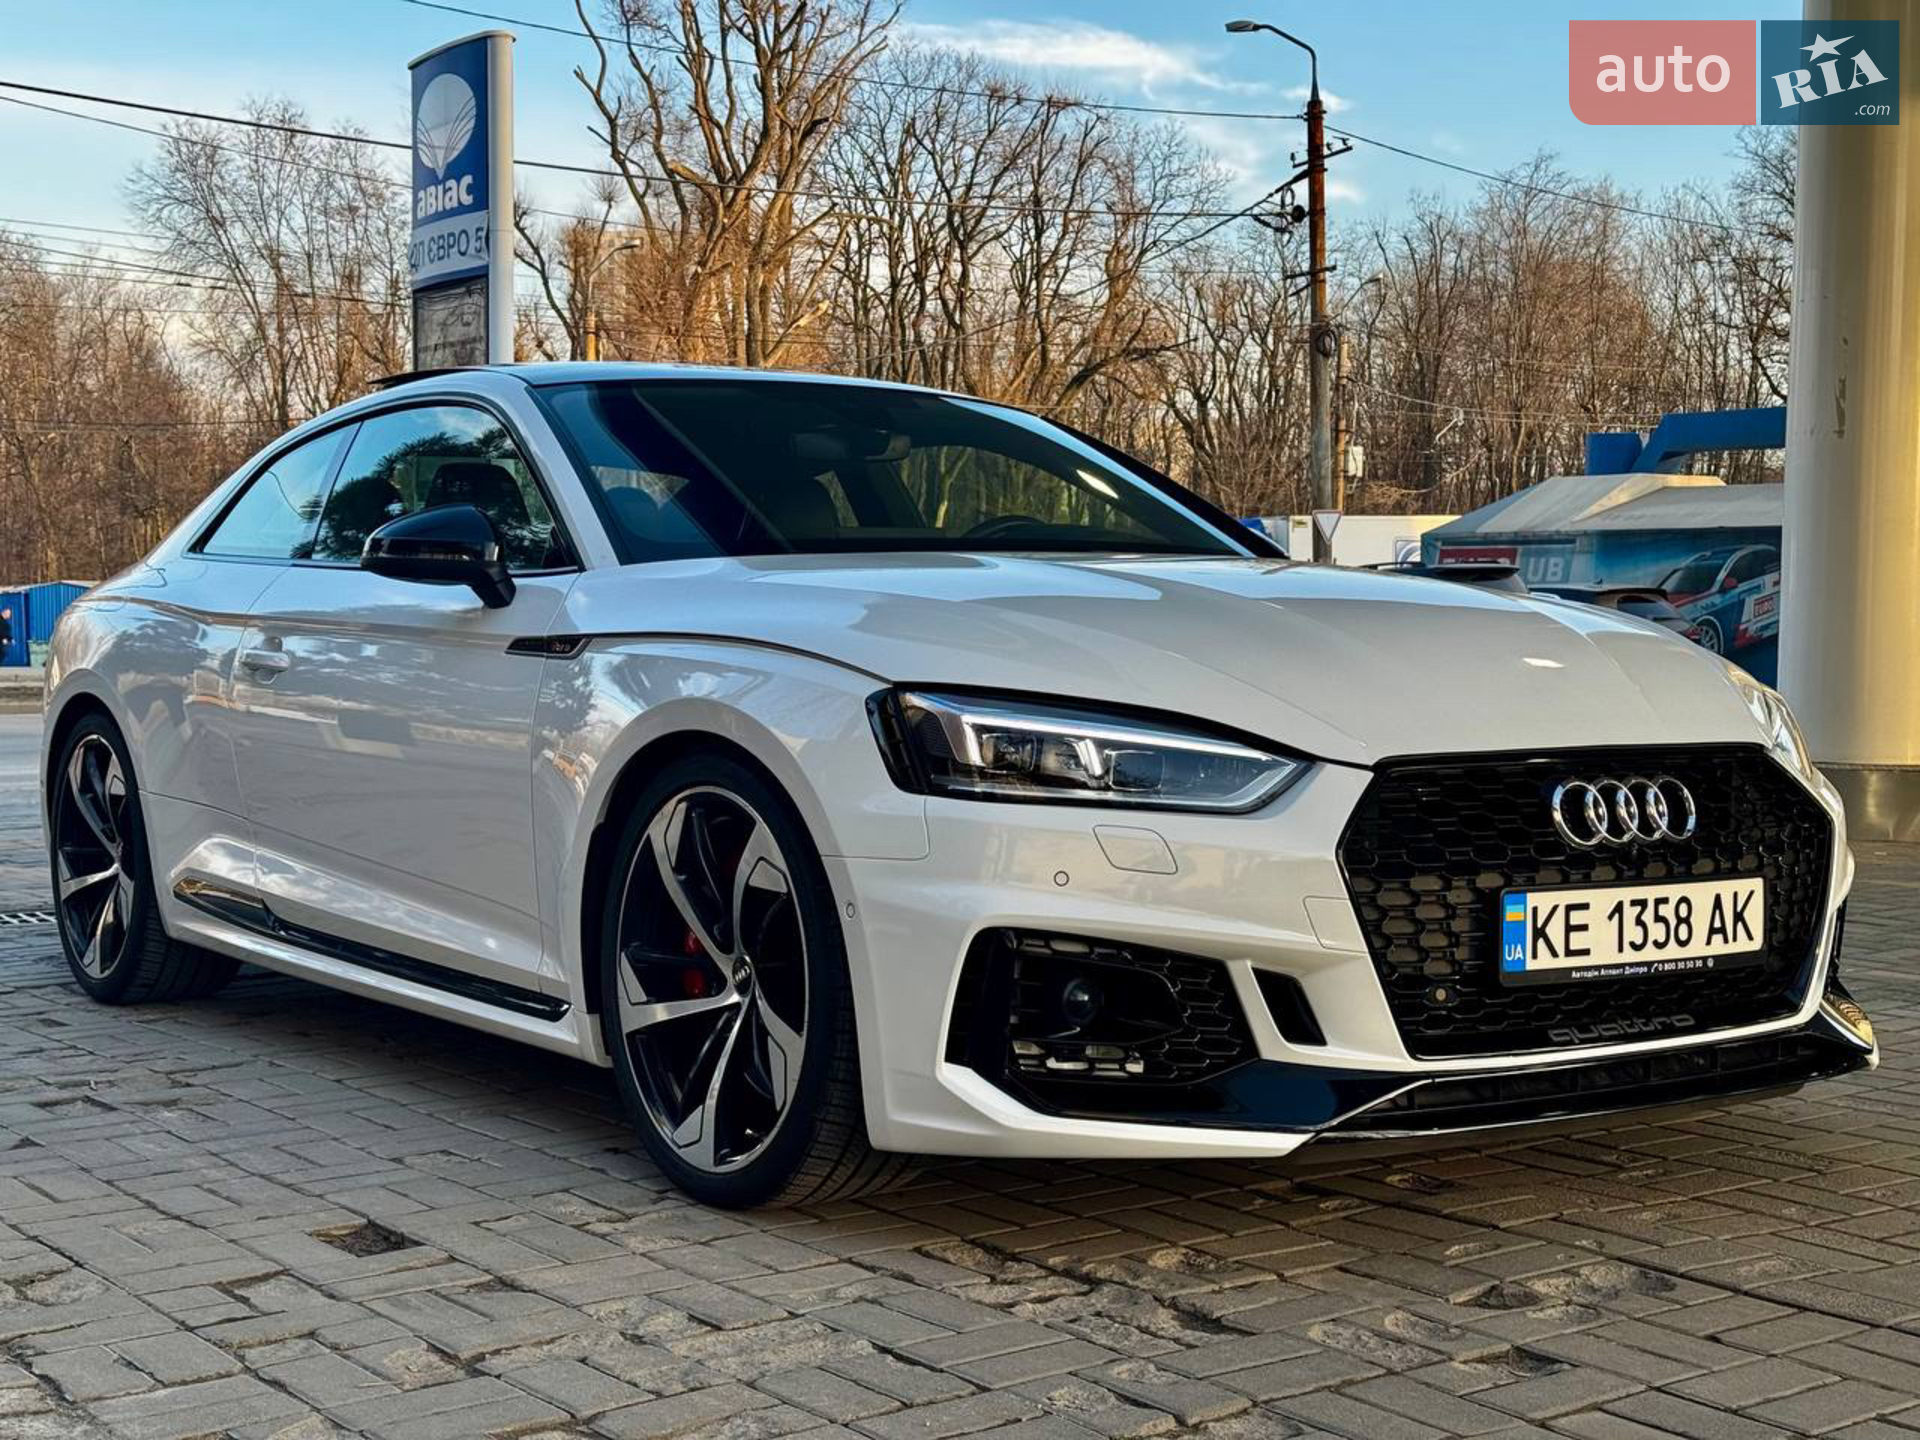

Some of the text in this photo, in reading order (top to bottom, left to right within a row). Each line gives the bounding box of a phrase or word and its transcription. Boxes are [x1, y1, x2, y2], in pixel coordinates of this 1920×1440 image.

[427, 229, 470, 265] ЄВРО
[474, 226, 485, 254] 5
[1531, 889, 1756, 960] KE 1358 AK
[1505, 944, 1525, 961] UA
[1547, 1012, 1696, 1045] quattro
